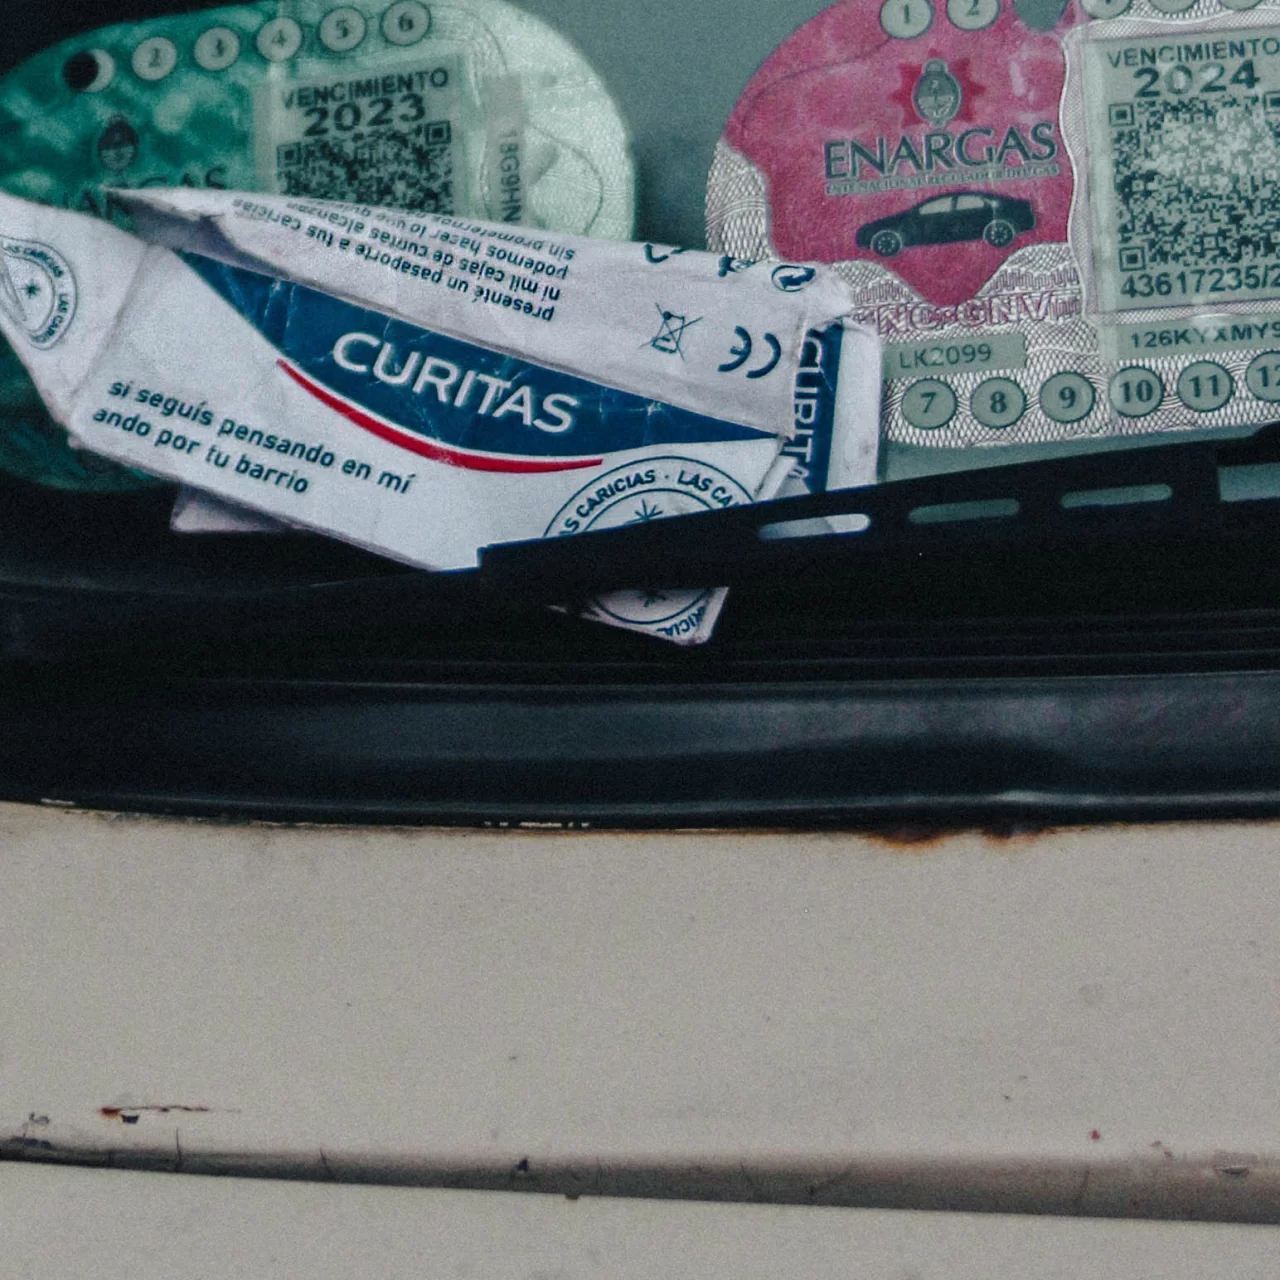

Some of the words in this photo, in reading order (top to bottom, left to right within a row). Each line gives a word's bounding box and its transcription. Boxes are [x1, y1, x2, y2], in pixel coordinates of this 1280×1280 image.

[398, 10, 413, 32] 6
[902, 3, 912, 24] 1
[1107, 38, 1280, 68] VENCIMIENTO
[283, 68, 449, 110] VENCIMIENTO
[1133, 59, 1261, 99] 2024
[304, 92, 426, 137] 2023
[825, 122, 1058, 180] ENARGAS
[231, 198, 302, 232] caricias
[305, 225, 334, 247] tus
[339, 237, 351, 250] a
[410, 223, 428, 238] lo
[428, 227, 482, 256] hacer
[354, 243, 443, 284] pasaporte
[433, 250, 455, 270] de
[485, 245, 569, 280] podemos
[548, 243, 576, 261] sin
[446, 275, 469, 294] un
[458, 258, 505, 282] cajas
[508, 274, 539, 294] mil
[473, 284, 555, 321] presenté
[542, 285, 561, 302] ni
[899, 343, 993, 369] LK2099
[332, 332, 578, 435] CURITAS
[921, 391, 938, 414] 7
[989, 390, 1007, 414] 8
[1059, 386, 1077, 410] 9
[1120, 379, 1154, 404] 10
[1188, 374, 1220, 399] 11
[92, 407, 152, 437] ando
[155, 428, 201, 455] por
[205, 444, 231, 468] tu
[235, 453, 310, 494] barrio
[107, 379, 132, 398] si
[134, 388, 214, 427] seguís
[218, 417, 336, 468] pensando
[341, 460, 372, 480] en
[376, 471, 417, 495] mí
[575, 469, 657, 518] CARICIAS
[676, 469, 714, 493] LAS
[710, 486, 742, 509] CA
